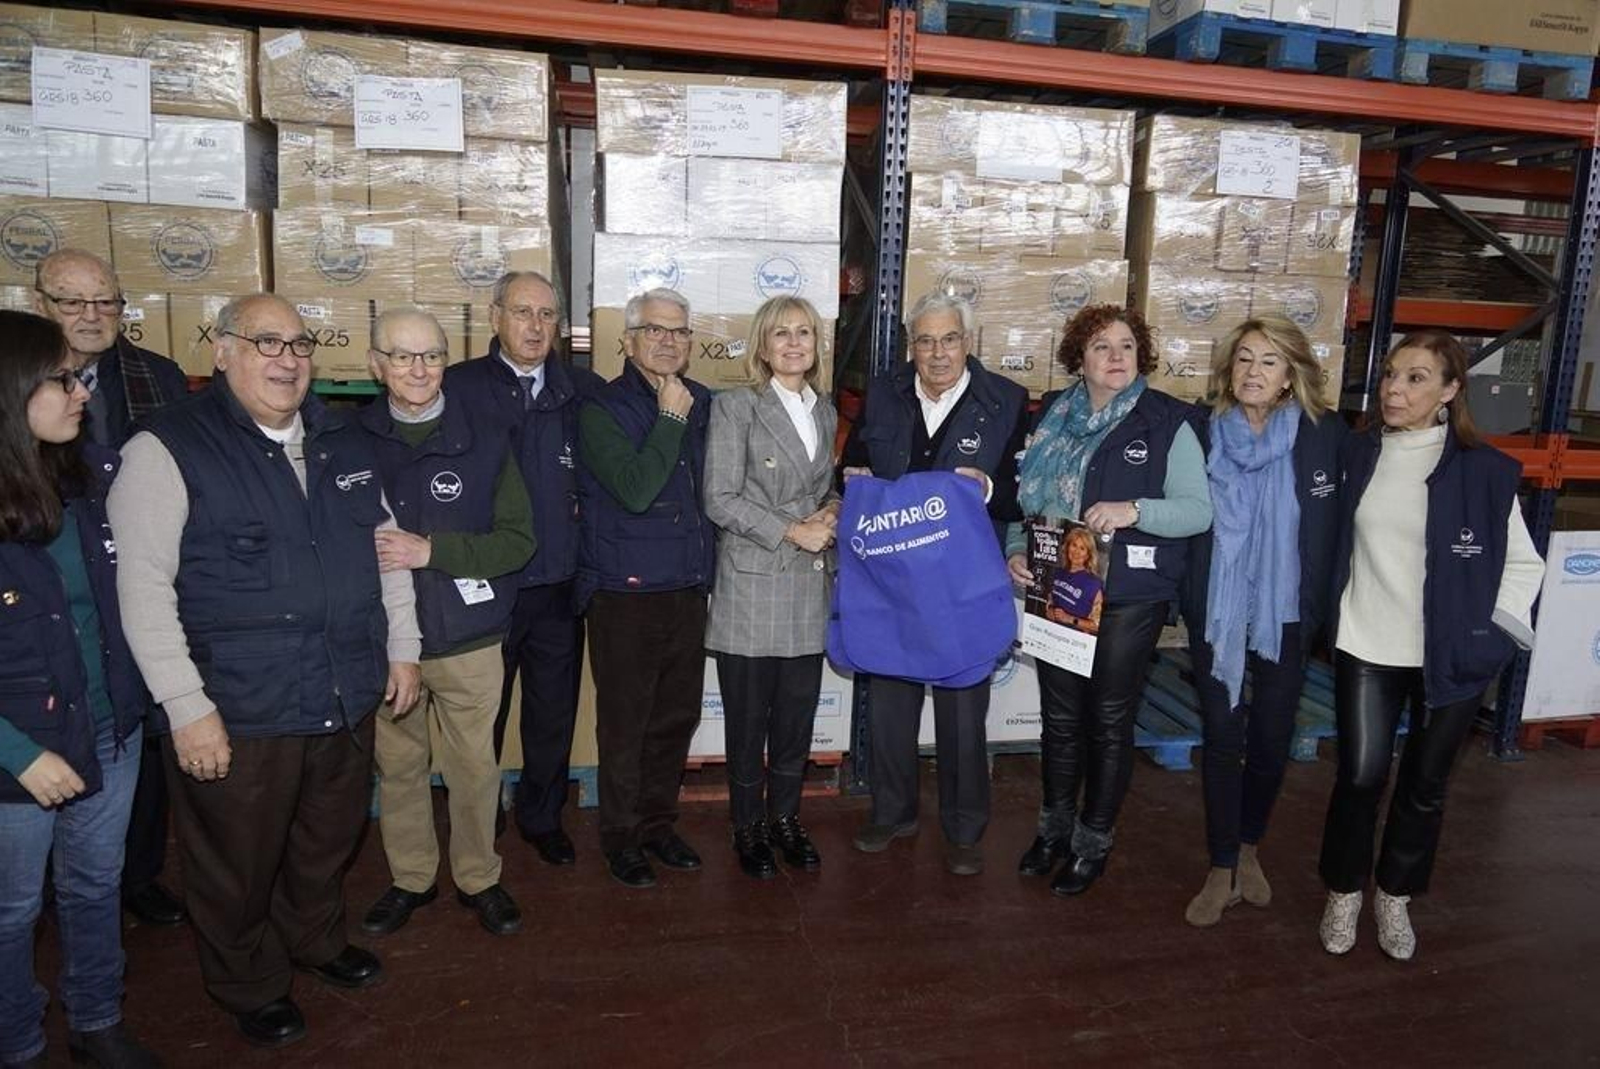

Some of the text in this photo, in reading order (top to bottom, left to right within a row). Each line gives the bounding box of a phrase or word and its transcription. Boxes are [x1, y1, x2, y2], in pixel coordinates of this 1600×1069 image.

[63, 60, 113, 80] PASTA
[82, 90, 113, 102] 360
[381, 88, 423, 101] PASTA
[403, 109, 430, 122] 360
[299, 305, 320, 315] PASTA
[307, 328, 350, 348] X25
[1163, 361, 1198, 378] X25
[865, 529, 950, 555] BANCO DE ALIMENTOS
